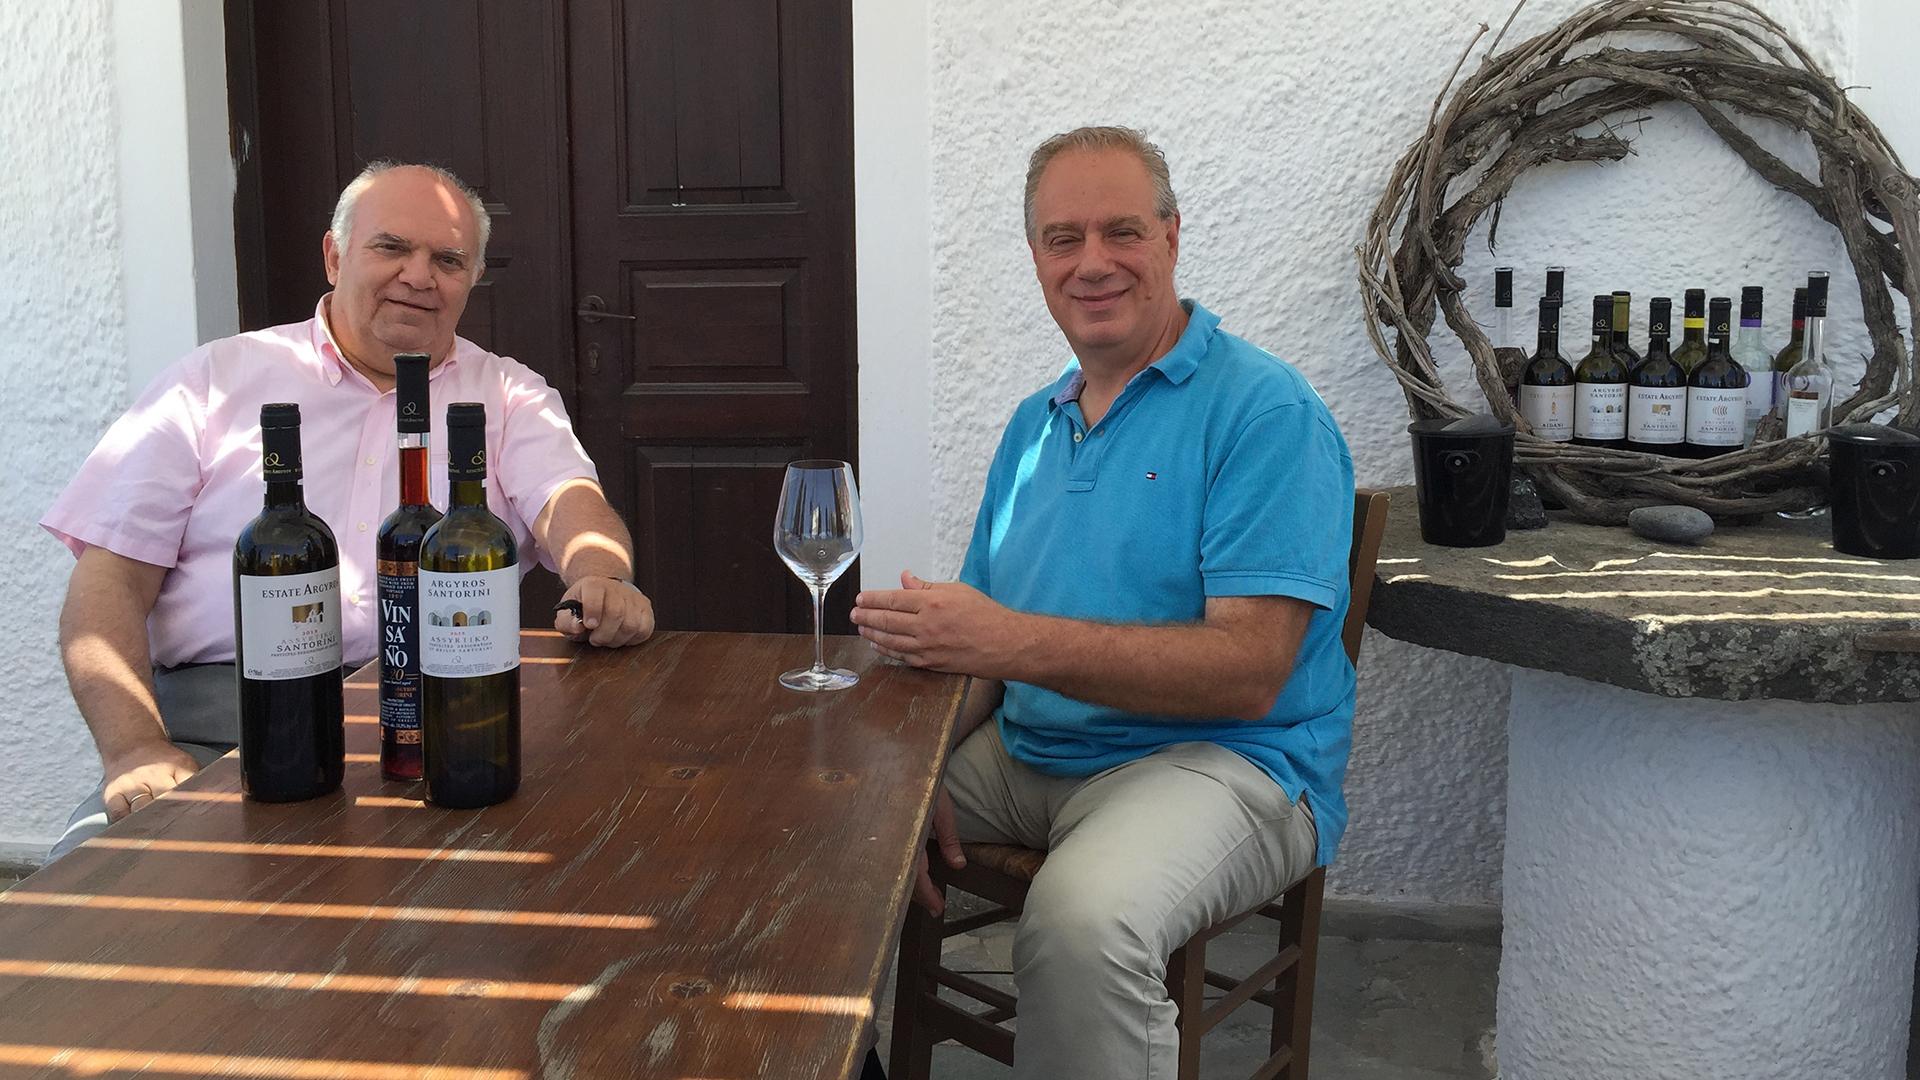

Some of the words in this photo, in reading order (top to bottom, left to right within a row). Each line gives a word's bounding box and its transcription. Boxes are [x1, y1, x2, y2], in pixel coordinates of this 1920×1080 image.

[431, 578, 486, 588] ARGYROS
[262, 588, 301, 599] ESTATE
[428, 588, 491, 598] SANTORINI
[381, 598, 412, 623] VIN
[276, 635, 336, 653] SANTORINI
